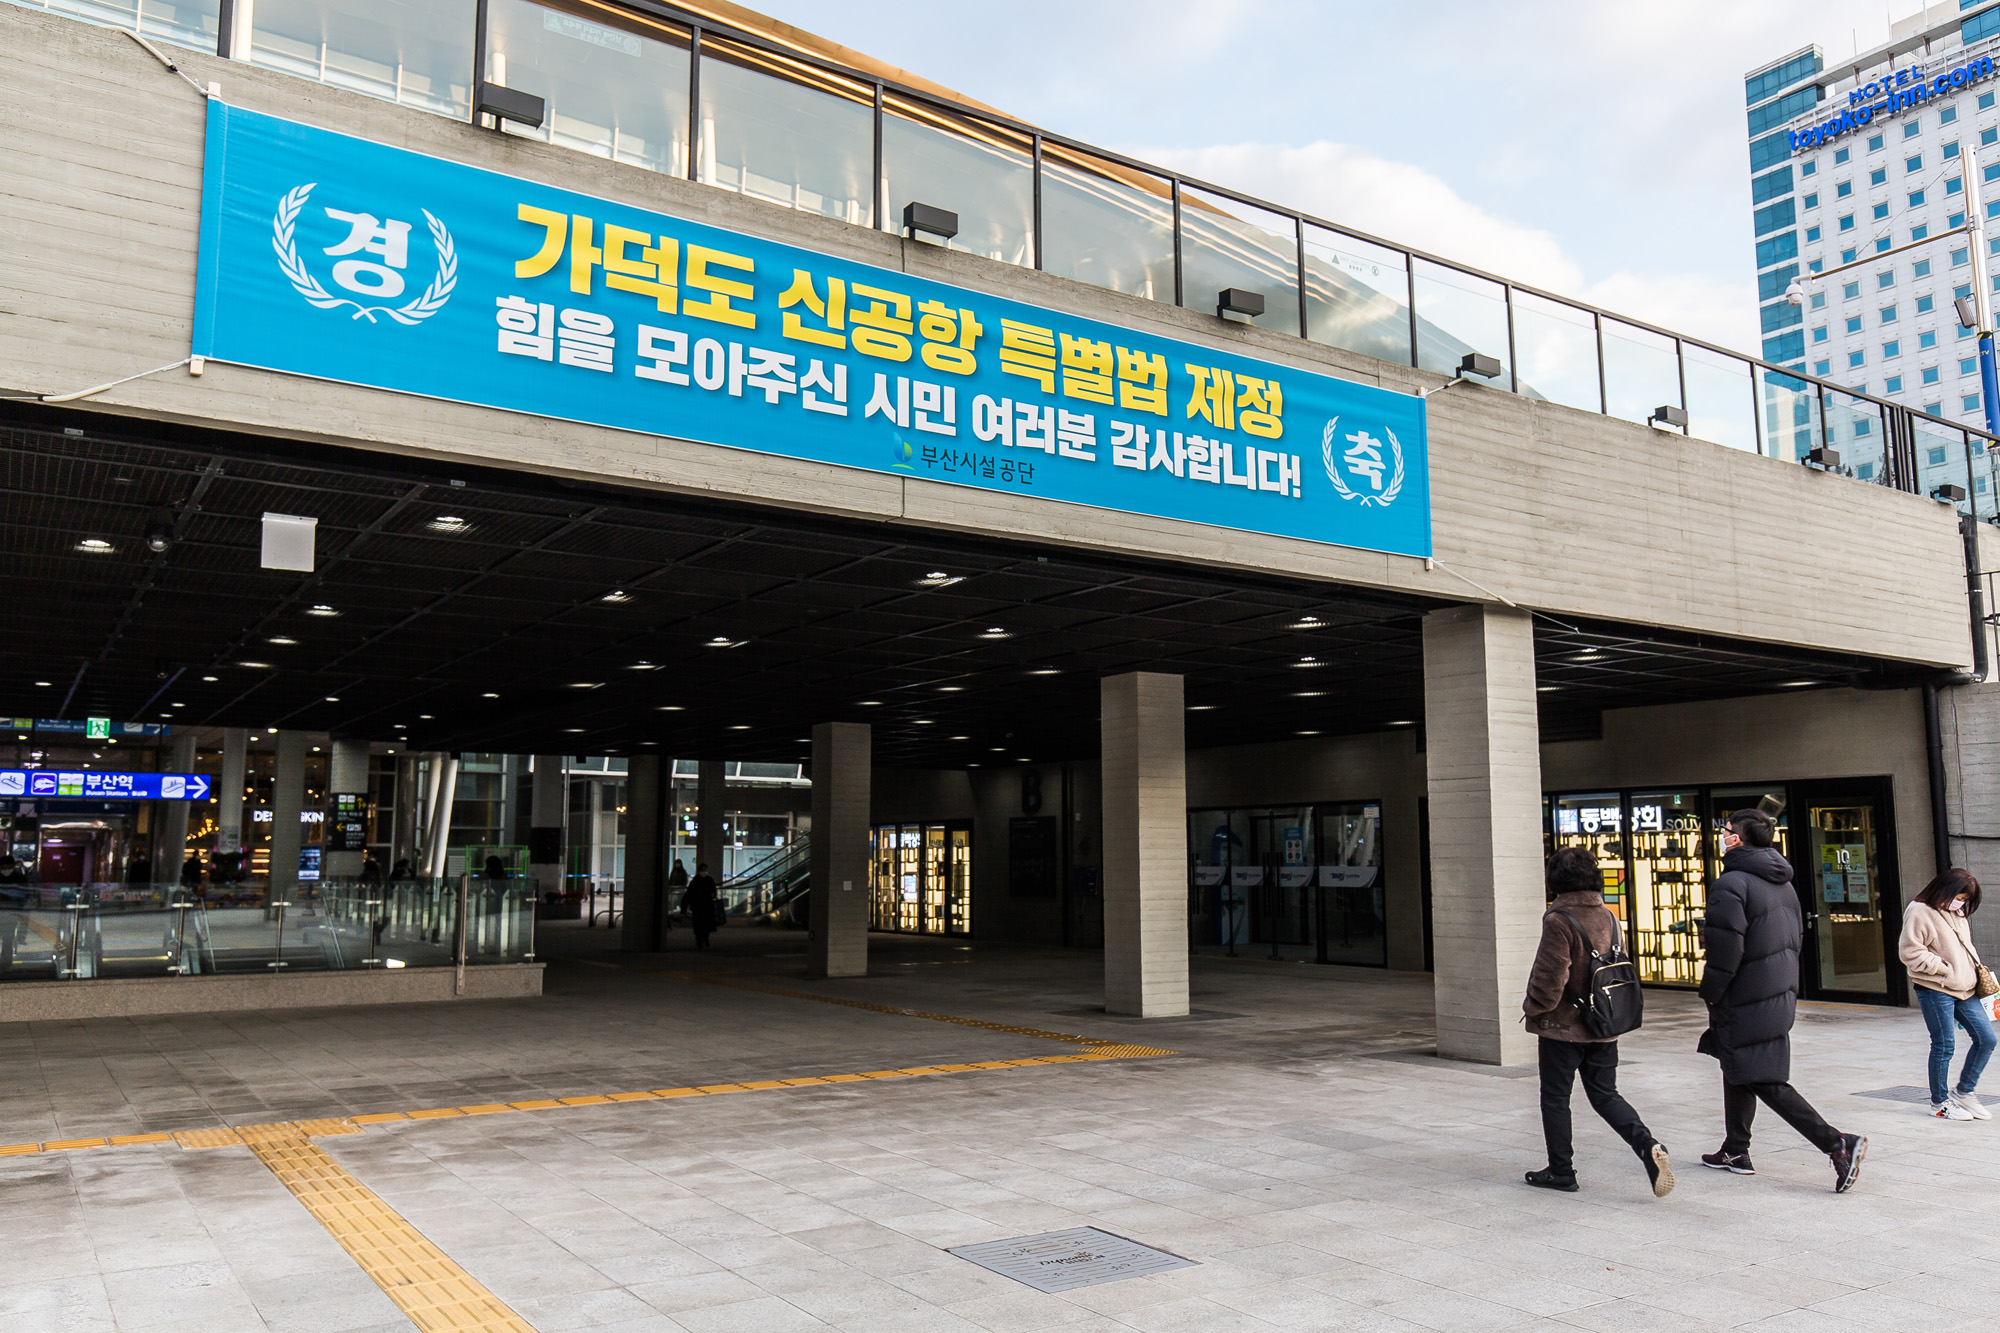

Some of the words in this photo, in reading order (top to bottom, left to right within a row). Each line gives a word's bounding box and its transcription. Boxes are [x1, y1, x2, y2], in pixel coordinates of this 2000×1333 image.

[1788, 56, 1993, 151] toyoko-inn.com
[1849, 65, 1924, 105] HOTEL
[323, 206, 412, 298] 경
[515, 203, 756, 329] 가덕도
[779, 268, 982, 376] 신공항
[999, 318, 1168, 418] 특별법
[1186, 362, 1284, 439] 제정
[496, 295, 615, 373] 힘을
[635, 324, 848, 416] 모아주신
[865, 373, 956, 437] 시민
[973, 393, 1096, 462] 여러분
[1110, 419, 1302, 498] 감사합니다!
[921, 445, 1035, 485] 부산시설공단
[1342, 430, 1387, 490] 축
[86, 774, 134, 791] 부산역
